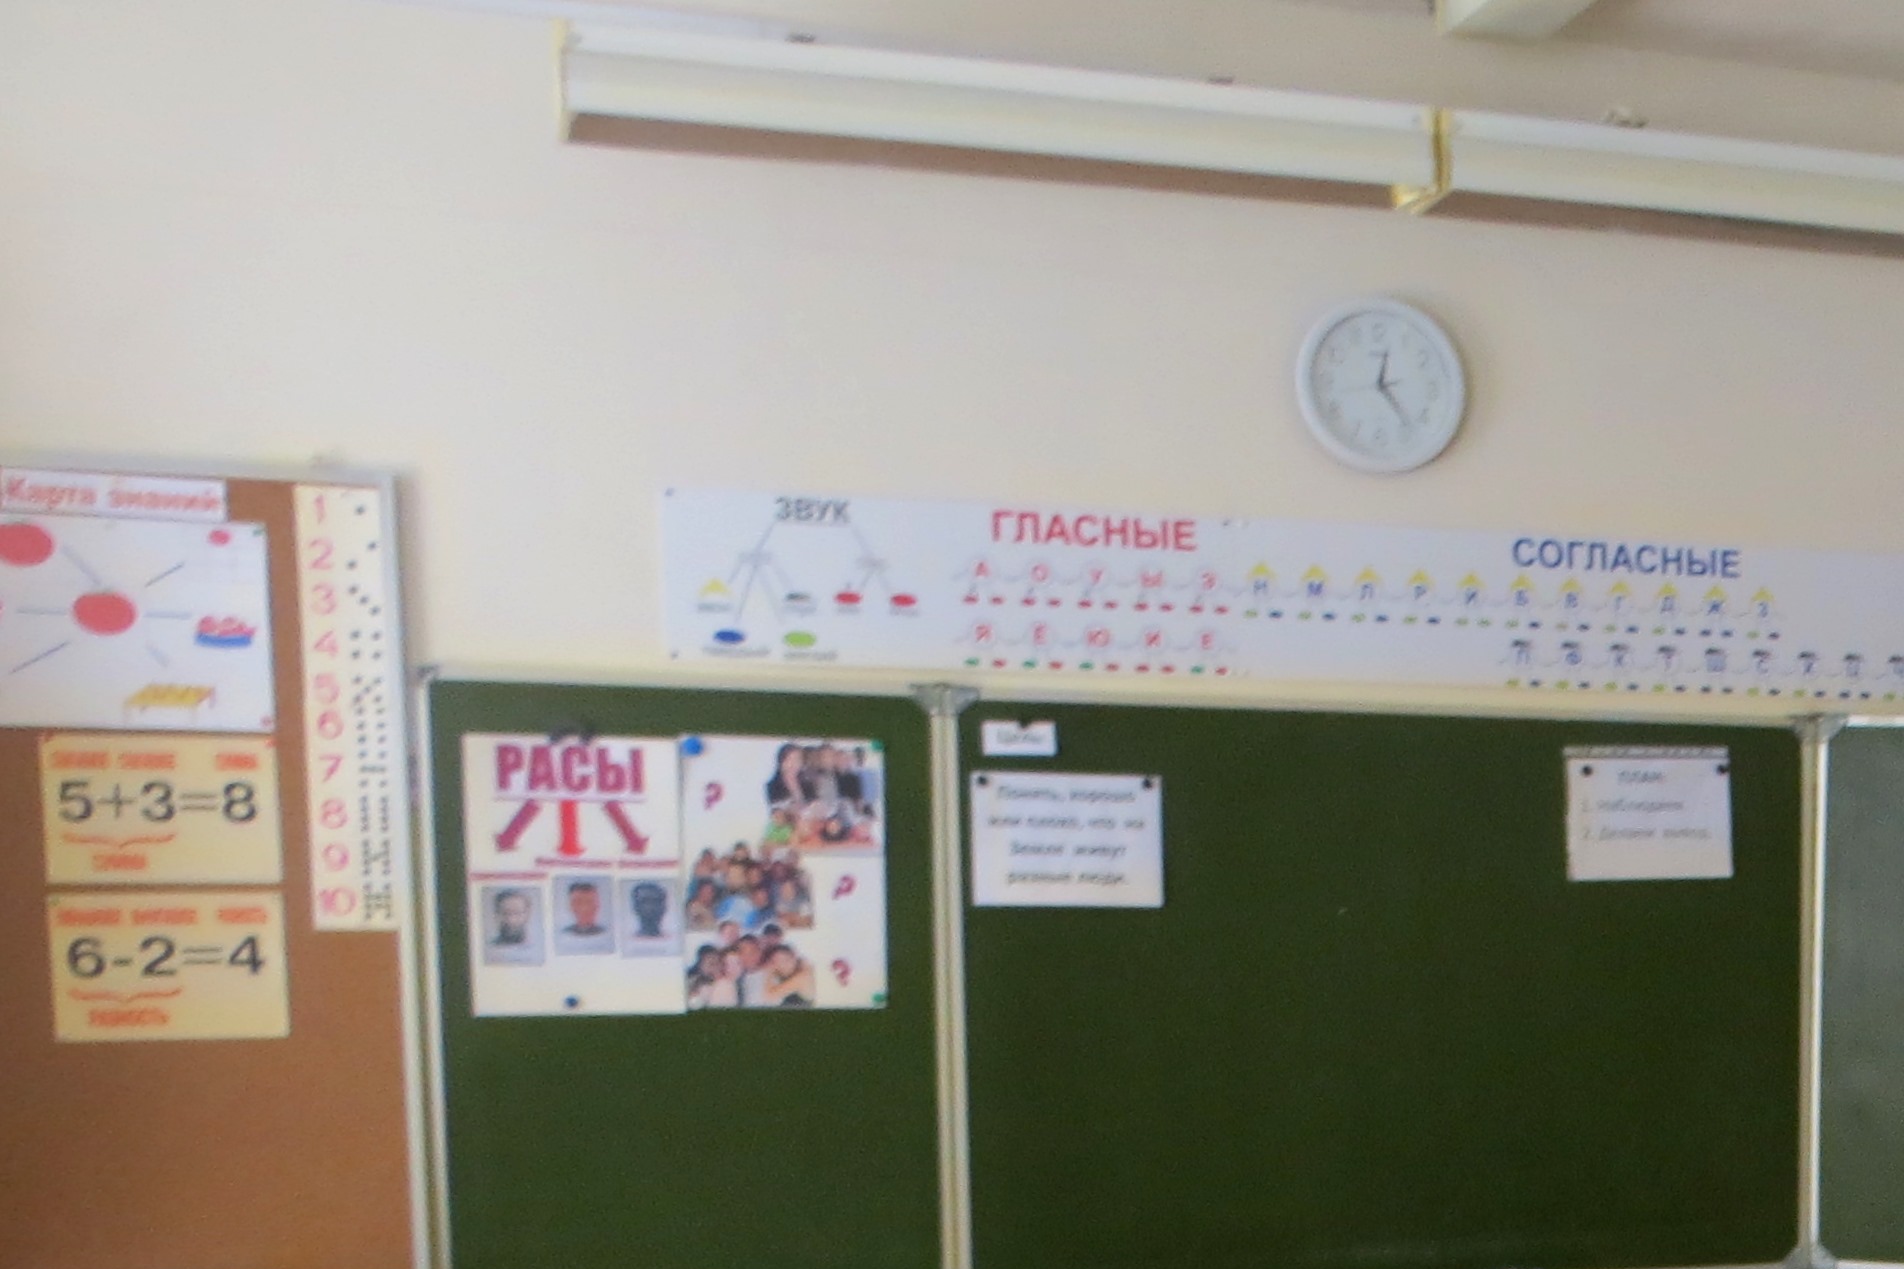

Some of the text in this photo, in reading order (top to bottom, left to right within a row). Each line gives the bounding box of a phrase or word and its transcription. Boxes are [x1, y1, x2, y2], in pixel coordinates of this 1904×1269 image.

[315, 495, 326, 524] 1
[775, 496, 849, 524] ЗВУК
[991, 510, 1196, 551] ГЛАСНЫЕ
[309, 538, 334, 570] 2
[1512, 537, 1740, 578] СОГЛАСНЫЕ
[975, 561, 989, 577] А
[1031, 564, 1048, 582] О
[312, 582, 337, 616] 3
[313, 629, 339, 657] 4
[314, 673, 340, 703] 5
[317, 711, 345, 740] 6
[319, 754, 344, 782] 7
[495, 744, 645, 794] РАСЫ
[57, 780, 258, 823] 5+3=8
[320, 798, 348, 830] 8
[322, 843, 350, 872] 9
[67, 935, 265, 977] 6-2=4
